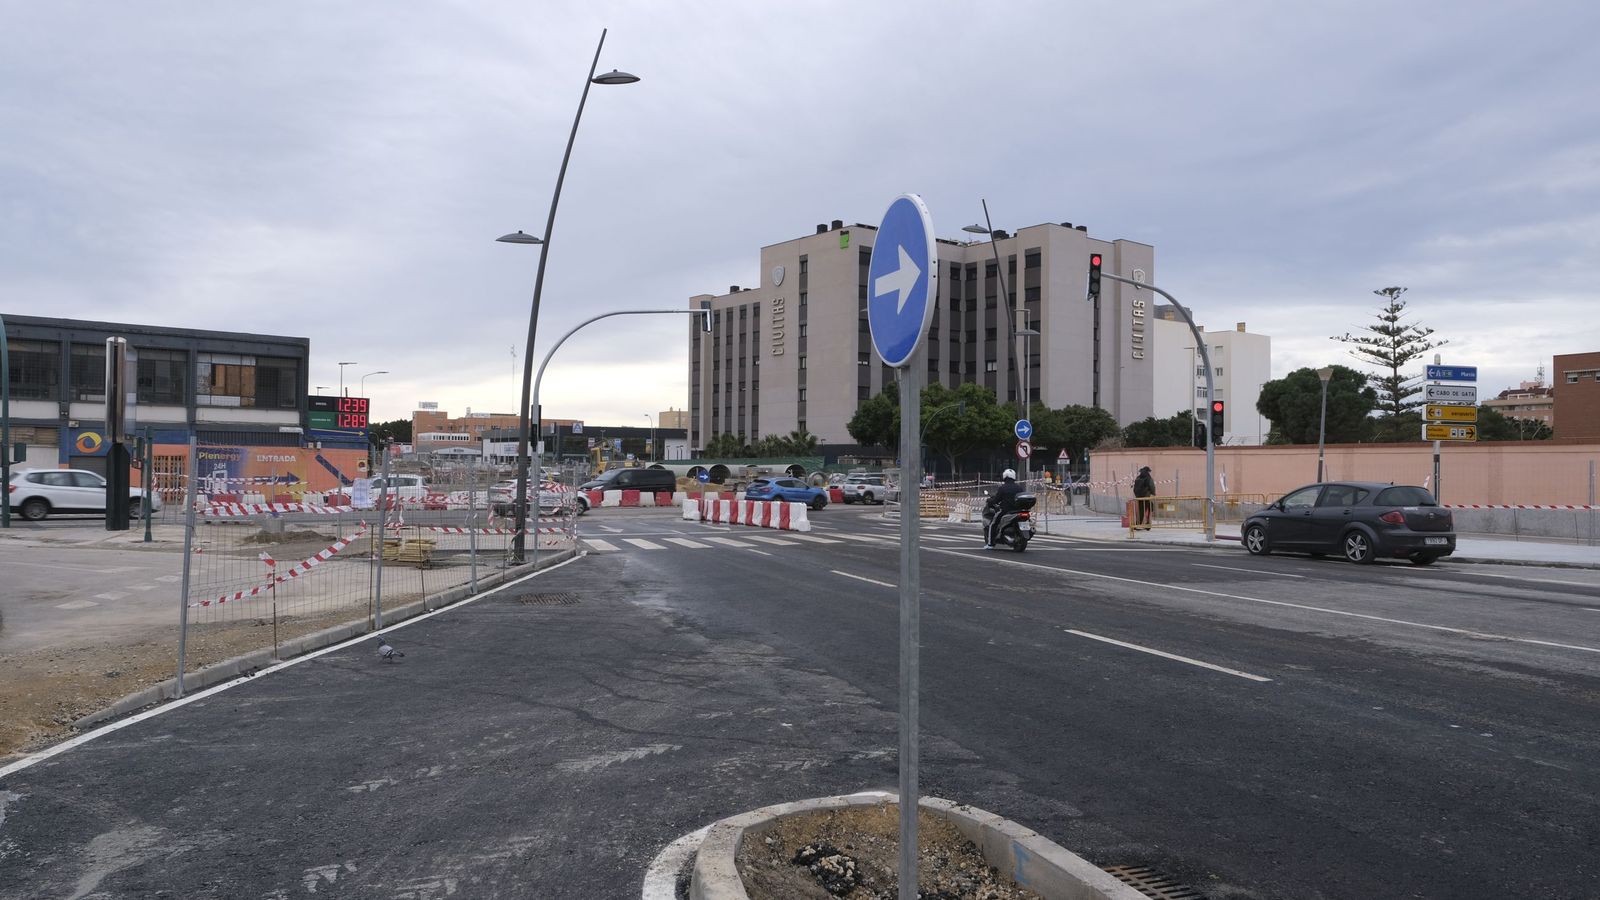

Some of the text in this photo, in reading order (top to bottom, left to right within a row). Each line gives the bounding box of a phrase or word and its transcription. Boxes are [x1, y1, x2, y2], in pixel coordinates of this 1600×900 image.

[338, 398, 367, 413] 1.239
[338, 413, 366, 428] 1.289
[213, 462, 227, 470] 24H
